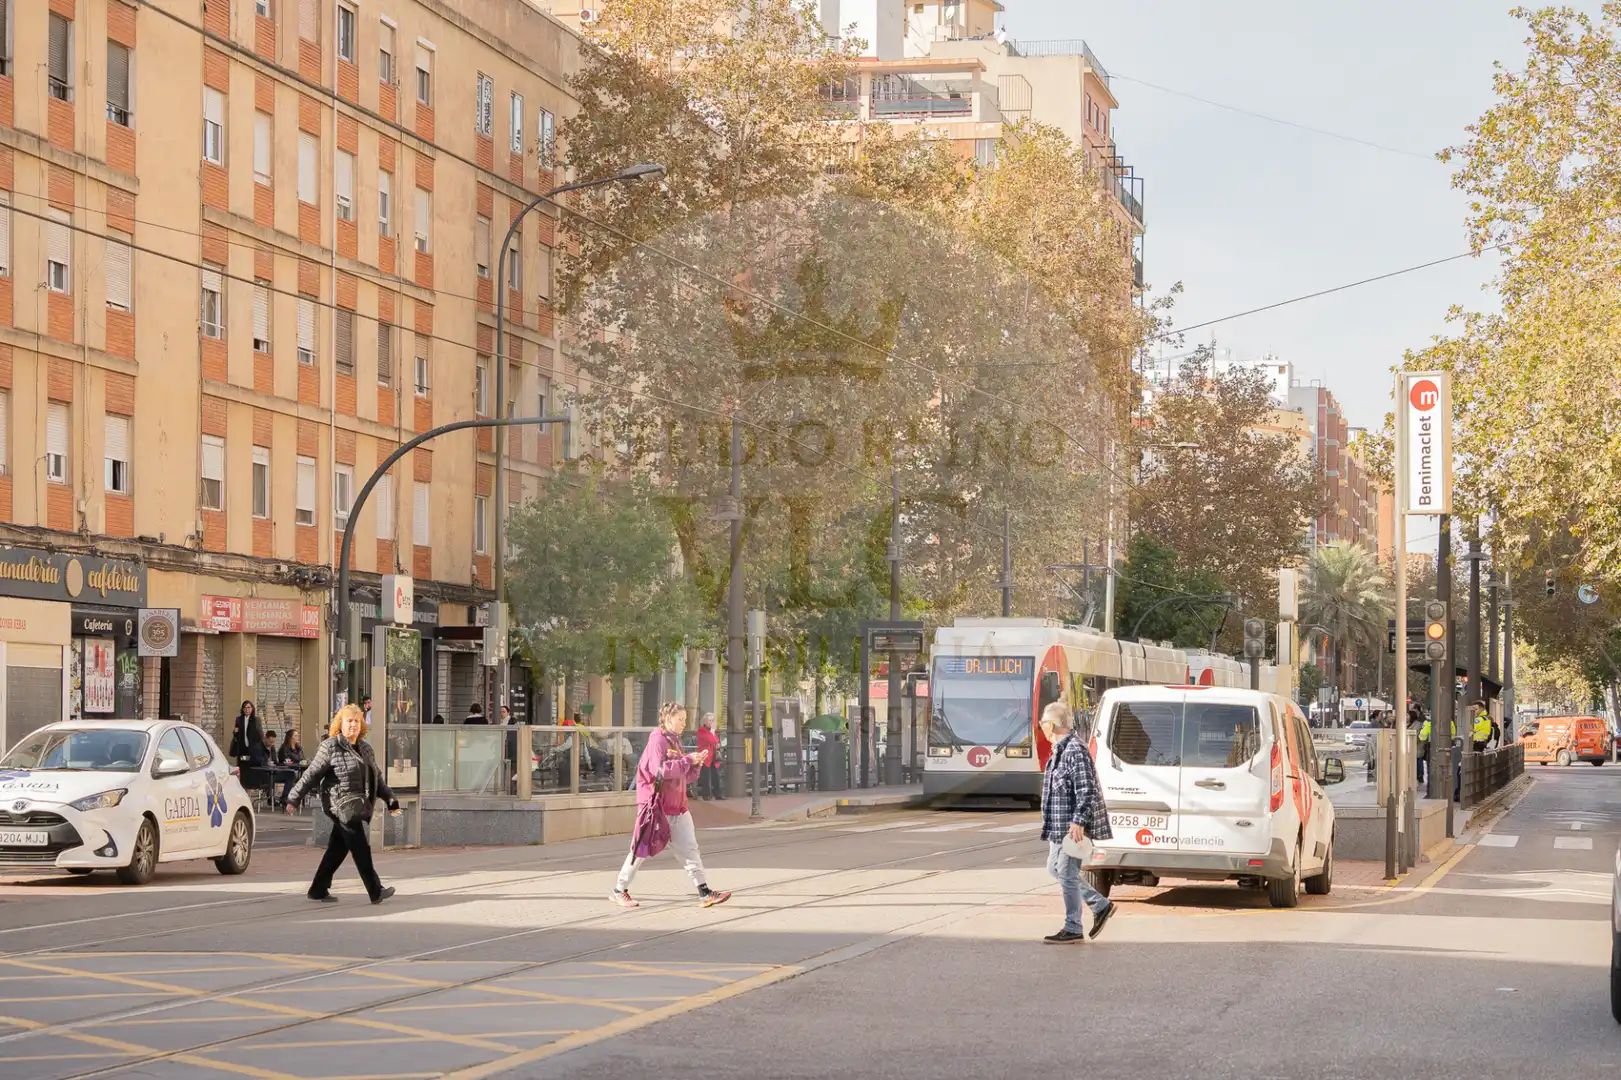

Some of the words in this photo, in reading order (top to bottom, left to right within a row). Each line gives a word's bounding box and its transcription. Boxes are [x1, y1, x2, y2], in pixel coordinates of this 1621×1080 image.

[1418, 415, 1432, 506] Benimaclet
[0, 556, 60, 584] anadería
[88, 563, 140, 598] cafetería
[965, 658, 983, 674] DR.
[985, 656, 1022, 674] LLUCH
[165, 796, 200, 820] GARDA
[1111, 815, 1139, 827] 8258
[1143, 816, 1164, 828] JBP
[25, 833, 45, 844] MJJ
